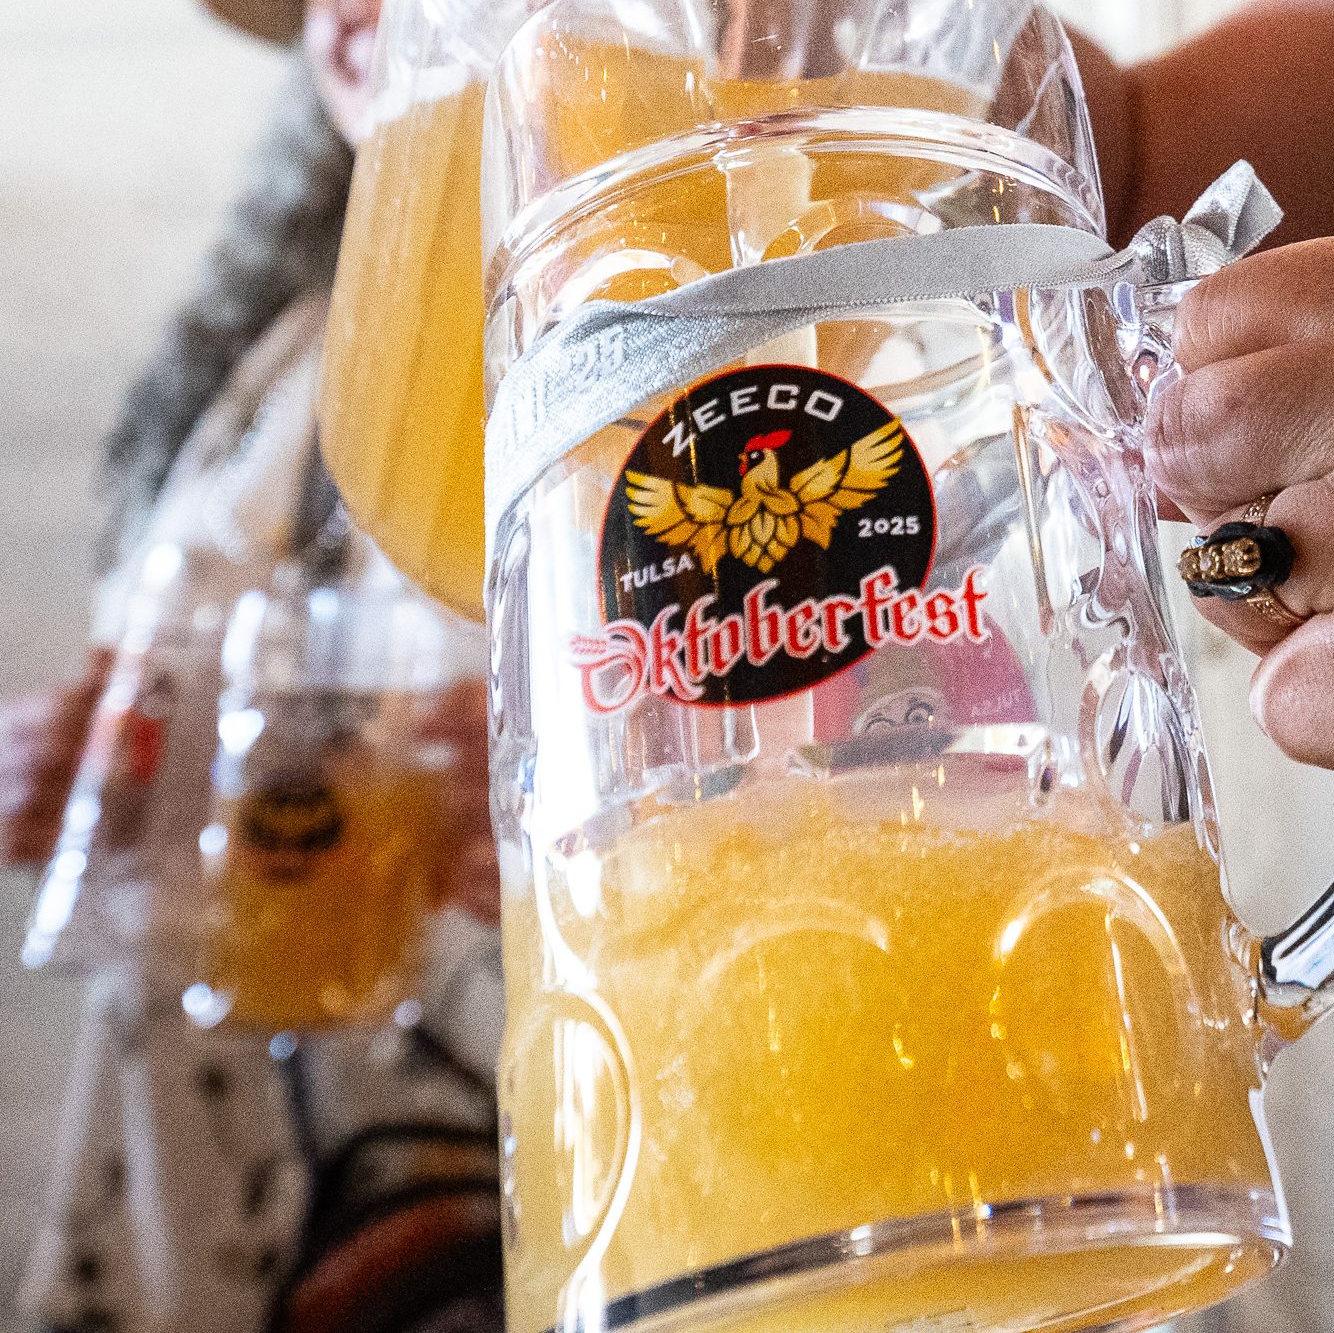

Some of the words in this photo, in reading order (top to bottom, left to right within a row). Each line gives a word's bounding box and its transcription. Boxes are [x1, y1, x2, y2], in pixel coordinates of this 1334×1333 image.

[661, 384, 844, 458] ZEECO
[857, 515, 921, 539] 2025
[619, 553, 695, 593] TULSA
[569, 565, 989, 714] Oktoberfest
